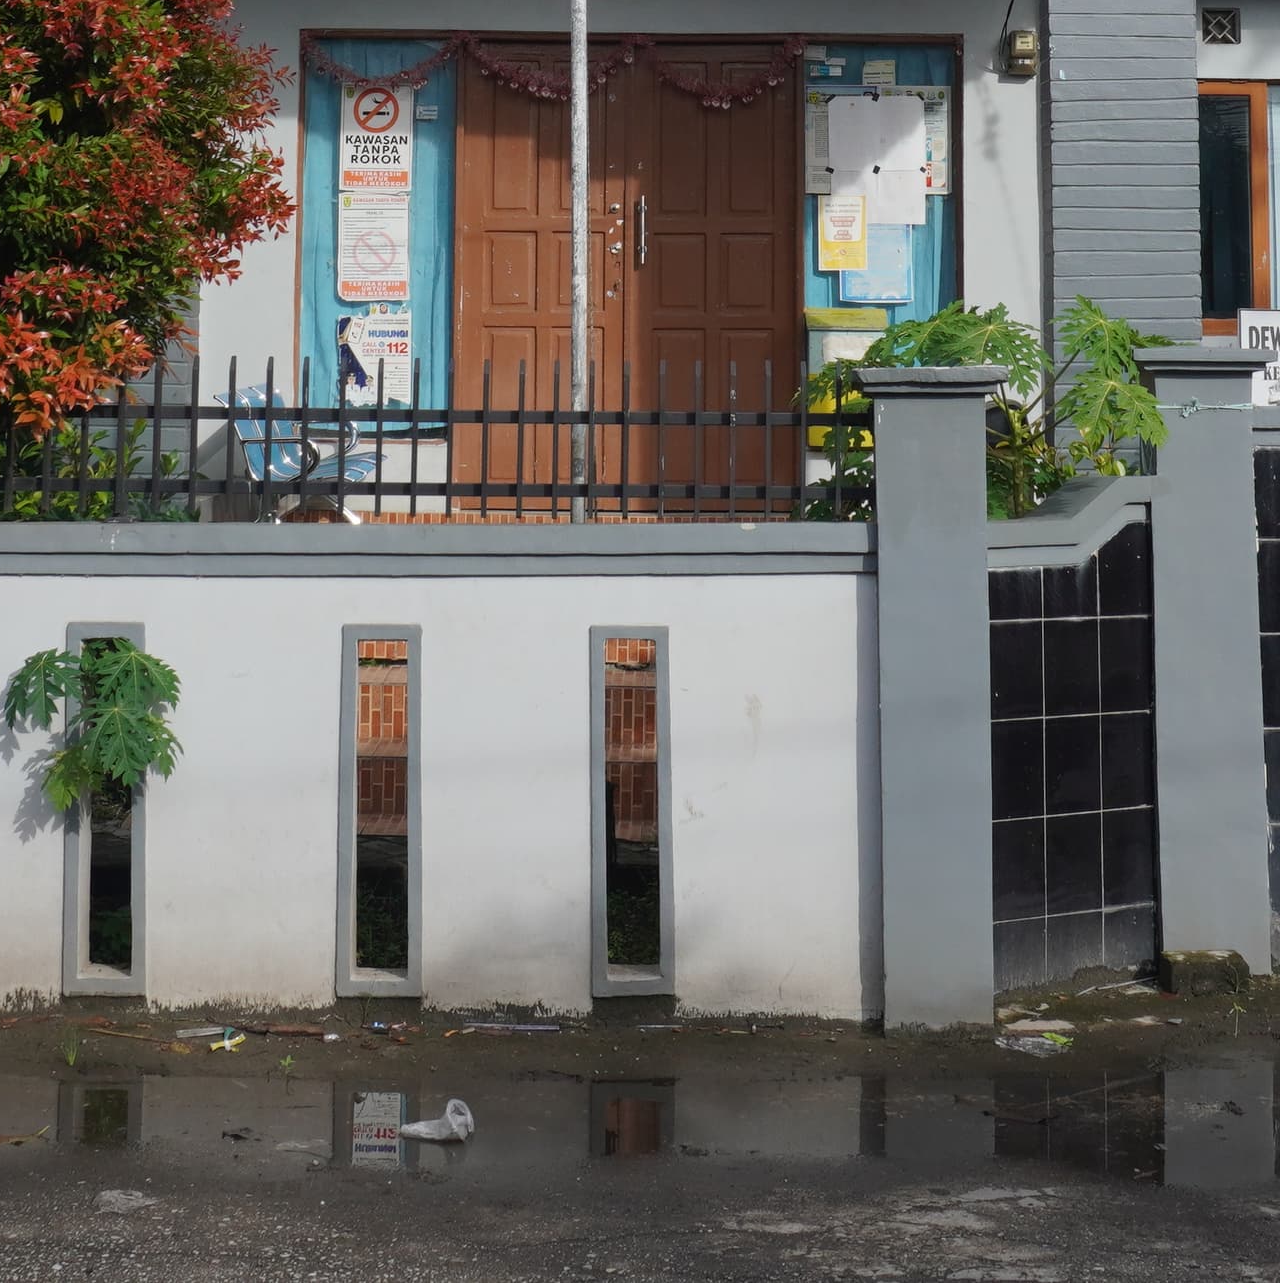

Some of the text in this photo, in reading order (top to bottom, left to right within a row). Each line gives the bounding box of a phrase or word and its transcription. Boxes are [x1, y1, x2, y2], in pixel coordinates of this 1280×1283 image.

[345, 135, 408, 145] KAWASAN
[353, 145, 399, 154] TANPA
[351, 155, 401, 164] ROKOK
[368, 330, 408, 338] HUBUNGI
[387, 342, 408, 353] 112
